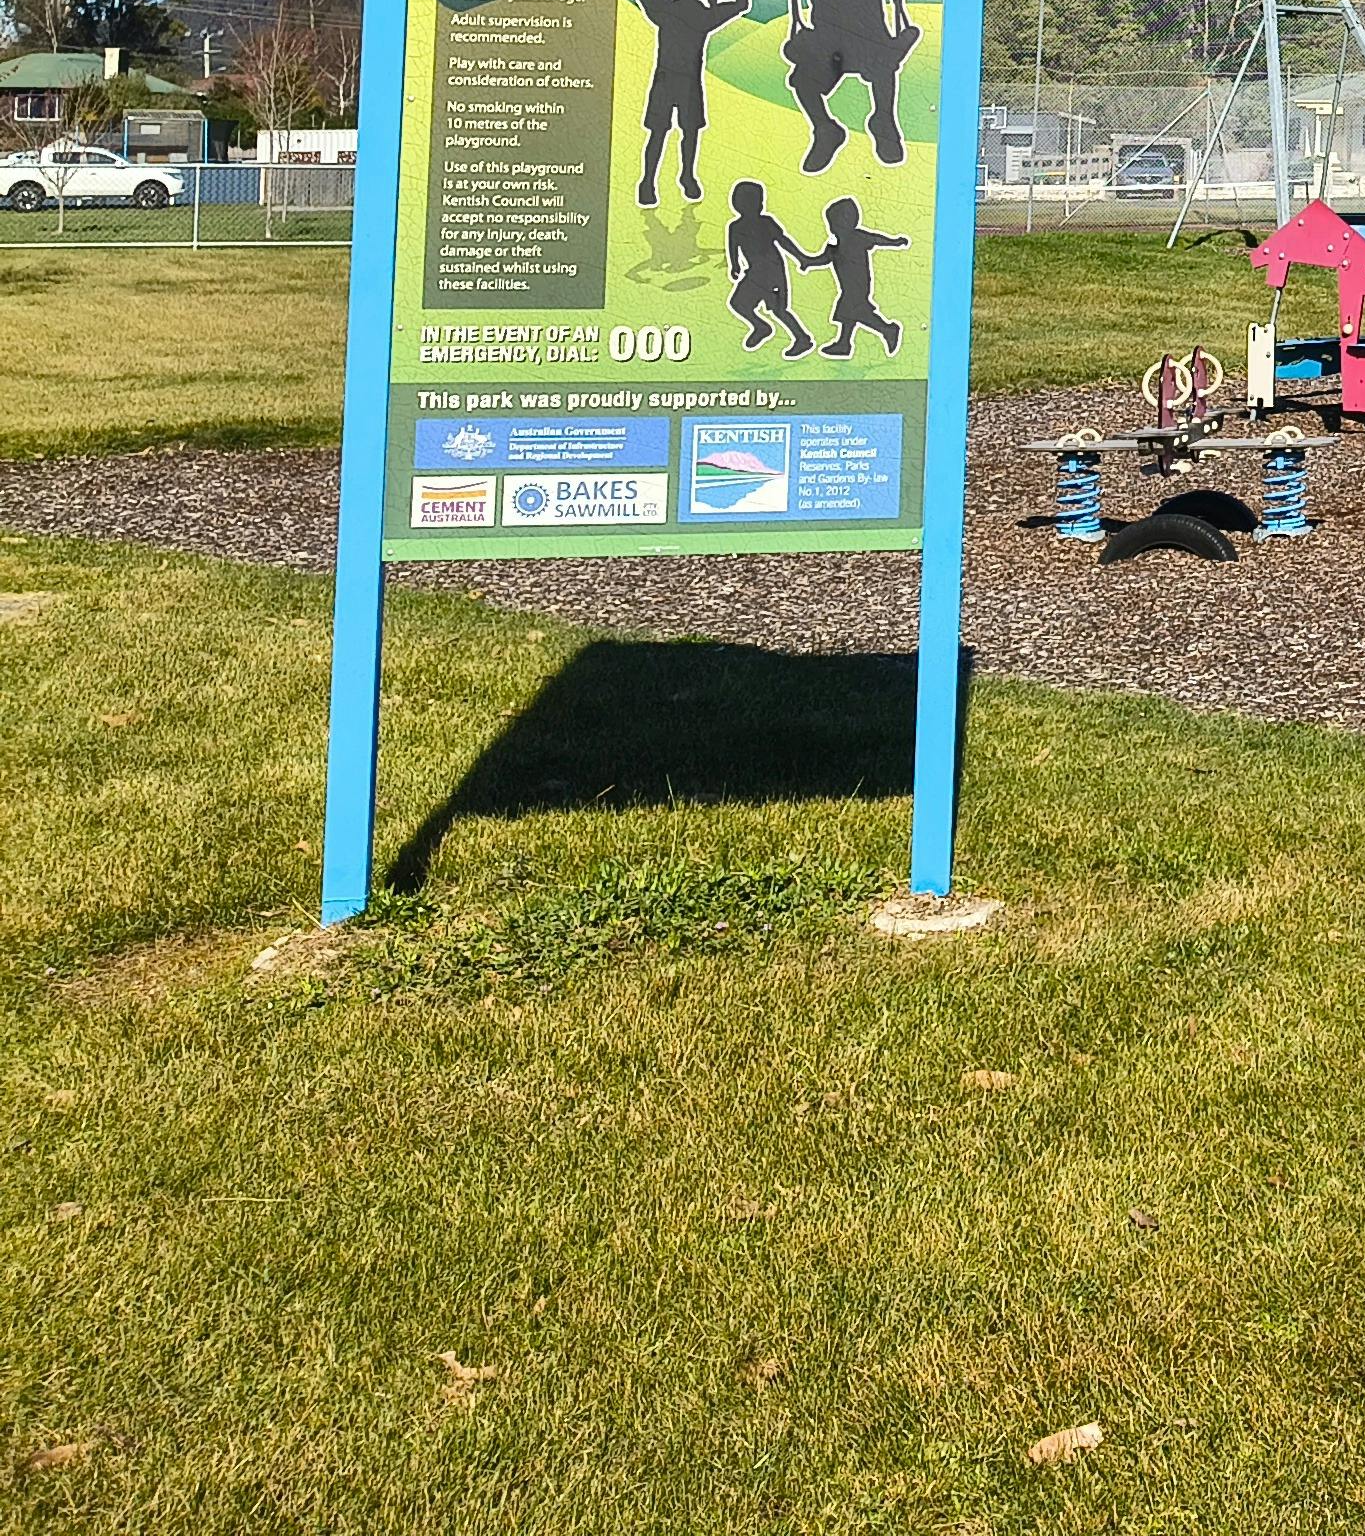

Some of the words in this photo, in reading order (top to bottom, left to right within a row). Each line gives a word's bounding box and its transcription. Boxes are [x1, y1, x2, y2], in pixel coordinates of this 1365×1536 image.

[450, 14, 485, 26] Adult
[488, 15, 559, 29] supervision
[563, 17, 572, 28] is
[450, 32, 545, 44] recommended.
[449, 57, 476, 71] Play
[478, 58, 505, 70] with
[508, 61, 535, 70] care
[538, 59, 561, 70] and
[447, 75, 533, 87] consideration
[536, 75, 551, 87] of
[551, 76, 594, 88] others.
[446, 101, 465, 112] No
[468, 101, 522, 115] smoking
[525, 102, 565, 114] within
[447, 118, 462, 129] 10
[465, 119, 508, 129] metres
[511, 118, 525, 129] of
[527, 119, 547, 130] the
[445, 134, 520, 148] playground.
[444, 161, 468, 173] Use
[470, 161, 485, 173] of
[486, 162, 509, 174] this
[512, 162, 584, 176] playground
[443, 179, 453, 190] is
[456, 179, 468, 190] at
[471, 181, 500, 192] your
[502, 180, 529, 190] own
[533, 179, 558, 191] risk.
[442, 195, 489, 207] Kentish
[492, 195, 539, 207] Council
[542, 196, 564, 207] will
[441, 213, 484, 225] accept
[487, 214, 503, 223] no
[506, 212, 590, 226] responsibility
[441, 228, 459, 240] for
[461, 230, 484, 242] any
[487, 229, 526, 242] injury,
[528, 229, 568, 241] death,
[440, 245, 492, 259] damage
[494, 246, 509, 256] or
[511, 244, 543, 257] theft
[439, 262, 500, 274] sustained
[502, 262, 541, 274] whilst
[543, 263, 577, 276] using
[438, 278, 474, 290] these
[476, 278, 531, 291] facilities.
[420, 326, 441, 343] IN
[444, 325, 479, 343] THE
[483, 326, 542, 343] EVENT
[546, 326, 570, 342] OF
[568, 326, 600, 343] AN
[609, 325, 691, 362] 000
[419, 345, 543, 365] EMERGENCY,
[546, 345, 600, 363] DIAL:
[418, 391, 460, 409] This
[466, 391, 514, 411] park
[520, 393, 561, 408] was
[567, 391, 644, 411] proudly
[647, 389, 750, 411] supported
[755, 390, 797, 411] by...
[510, 427, 562, 437] Australian
[564, 426, 626, 437] Government
[801, 424, 820, 434] This
[699, 429, 784, 444] KENTISH
[841, 436, 868, 446] under
[800, 448, 837, 459] Kentish
[840, 448, 878, 459] Council
[845, 461, 870, 471] Parks
[799, 474, 816, 483] and
[818, 473, 855, 484] Gardens
[557, 480, 638, 500] BAKES
[826, 486, 850, 496] 2012
[420, 501, 486, 514] CEMENT
[555, 503, 641, 518] SAWMILL
[421, 512, 485, 523] AUSTRALIA
